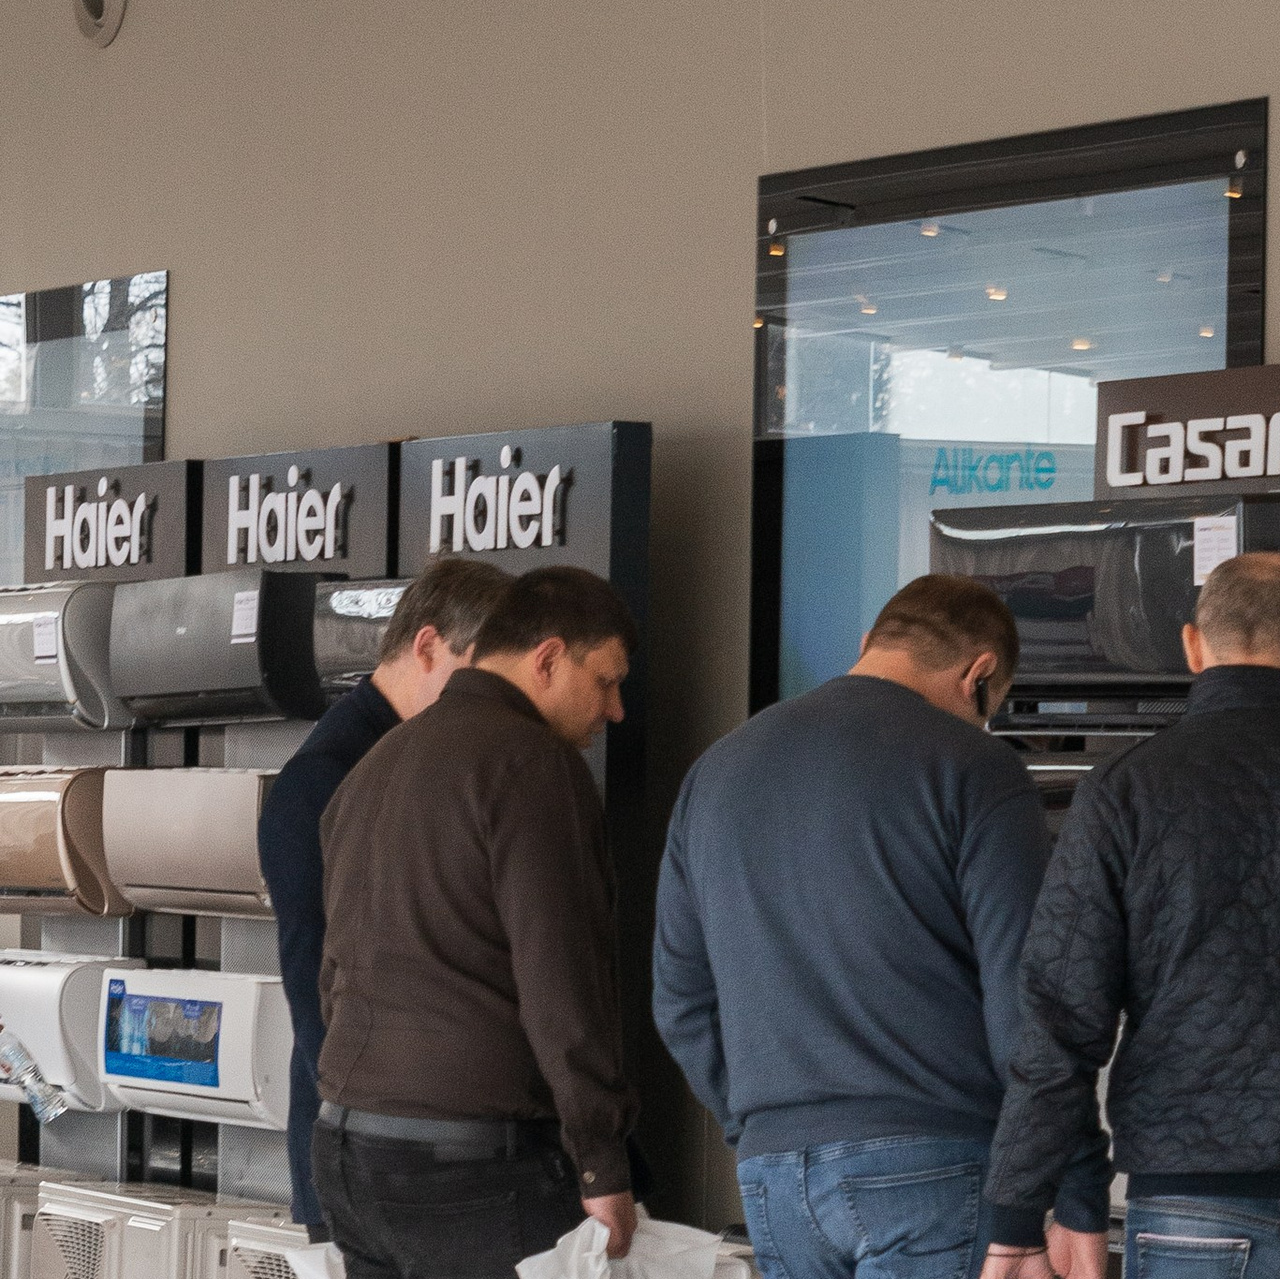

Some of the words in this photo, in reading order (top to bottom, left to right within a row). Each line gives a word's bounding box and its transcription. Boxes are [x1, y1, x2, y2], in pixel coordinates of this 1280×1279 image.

[227, 465, 342, 565] Haier
[430, 445, 560, 553] Haier
[929, 444, 1057, 496] Alikante
[45, 476, 146, 570] Haier
